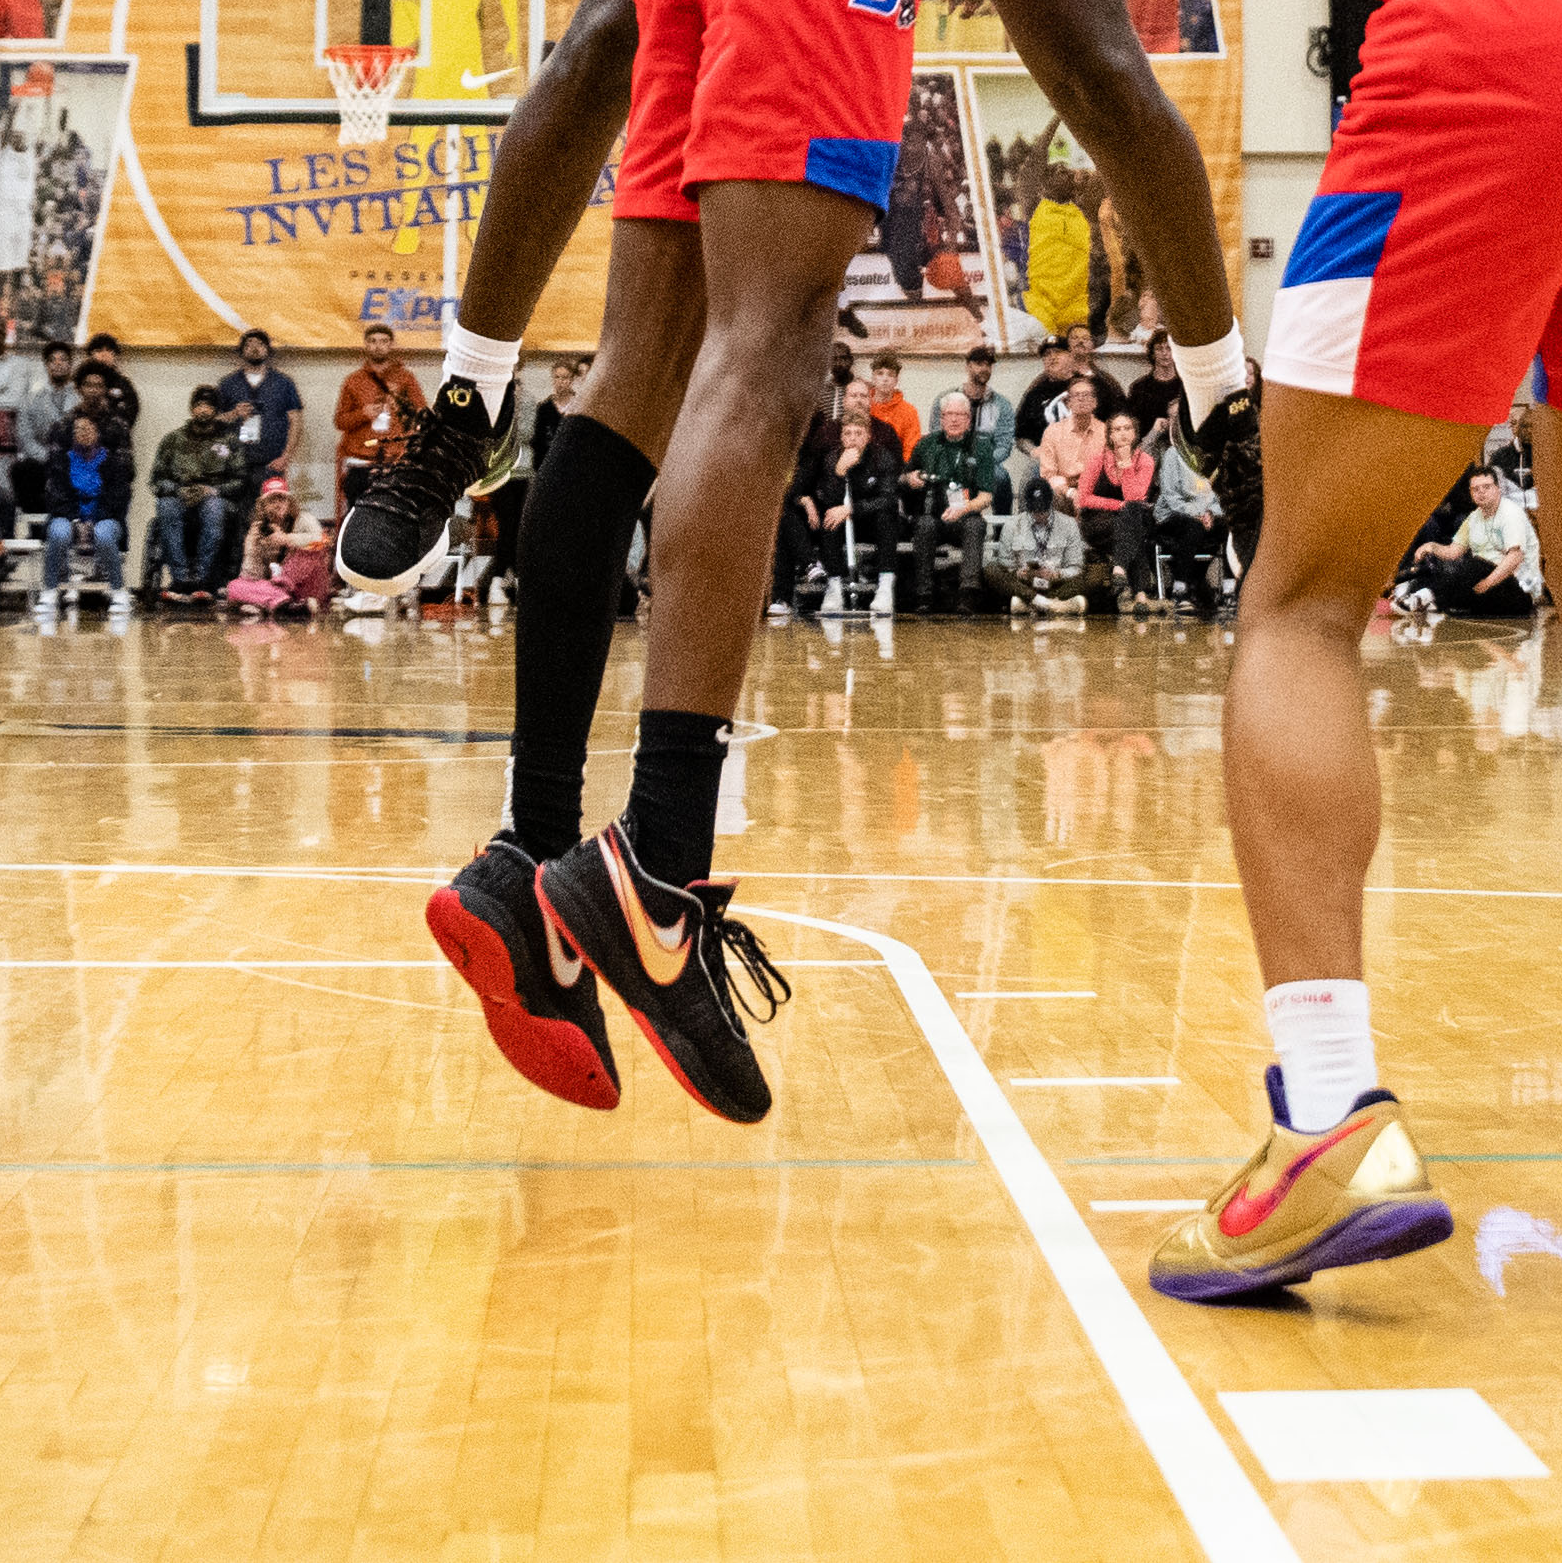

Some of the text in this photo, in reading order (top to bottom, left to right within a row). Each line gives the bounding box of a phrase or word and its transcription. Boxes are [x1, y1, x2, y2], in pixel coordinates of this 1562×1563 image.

[264, 132, 499, 195] LES SCH
[358, 287, 462, 324] Expr
